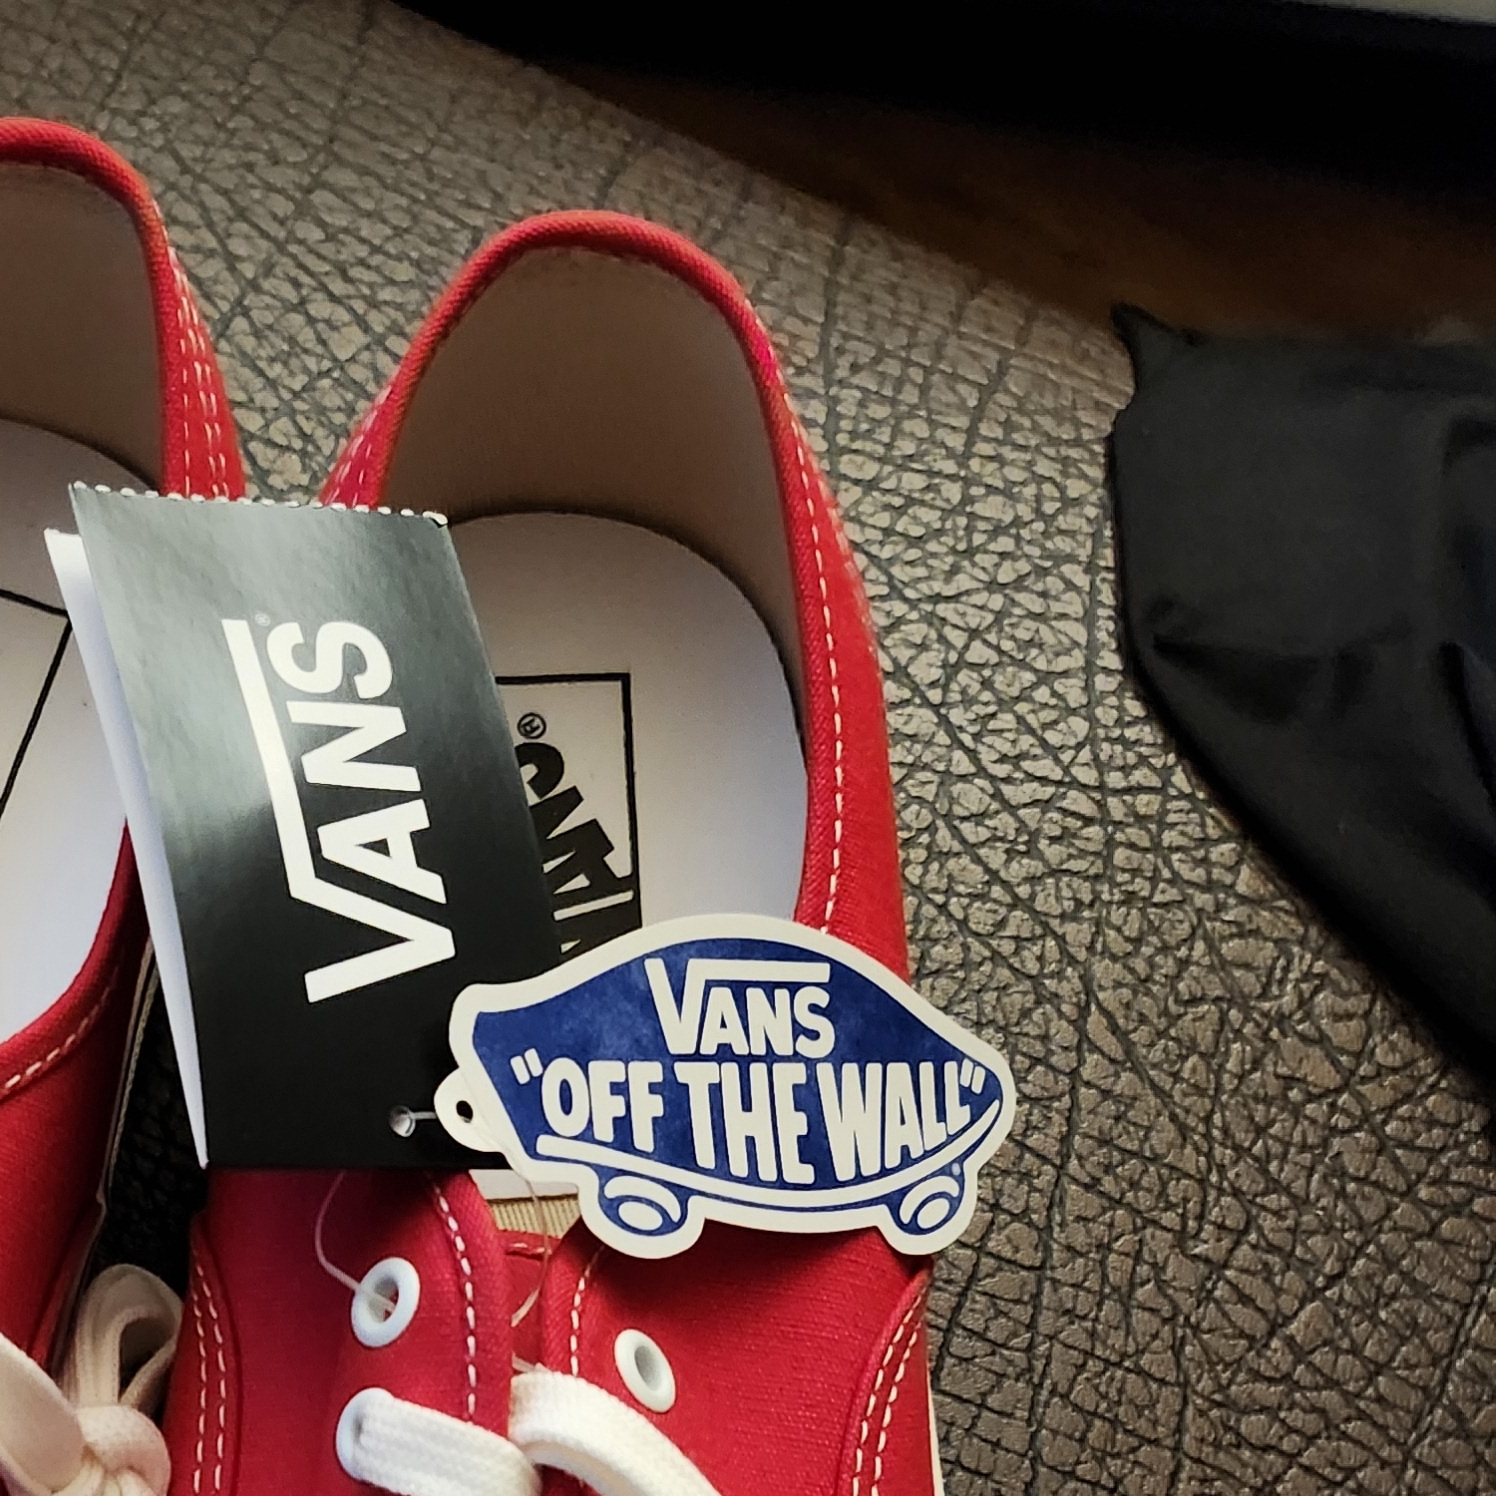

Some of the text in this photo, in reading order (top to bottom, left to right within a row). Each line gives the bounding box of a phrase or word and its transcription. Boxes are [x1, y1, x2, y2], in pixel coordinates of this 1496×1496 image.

[221, 619, 455, 1003] VANS
[644, 958, 835, 1058] VANS
[510, 1048, 986, 1184] "OFF THE WALL"
